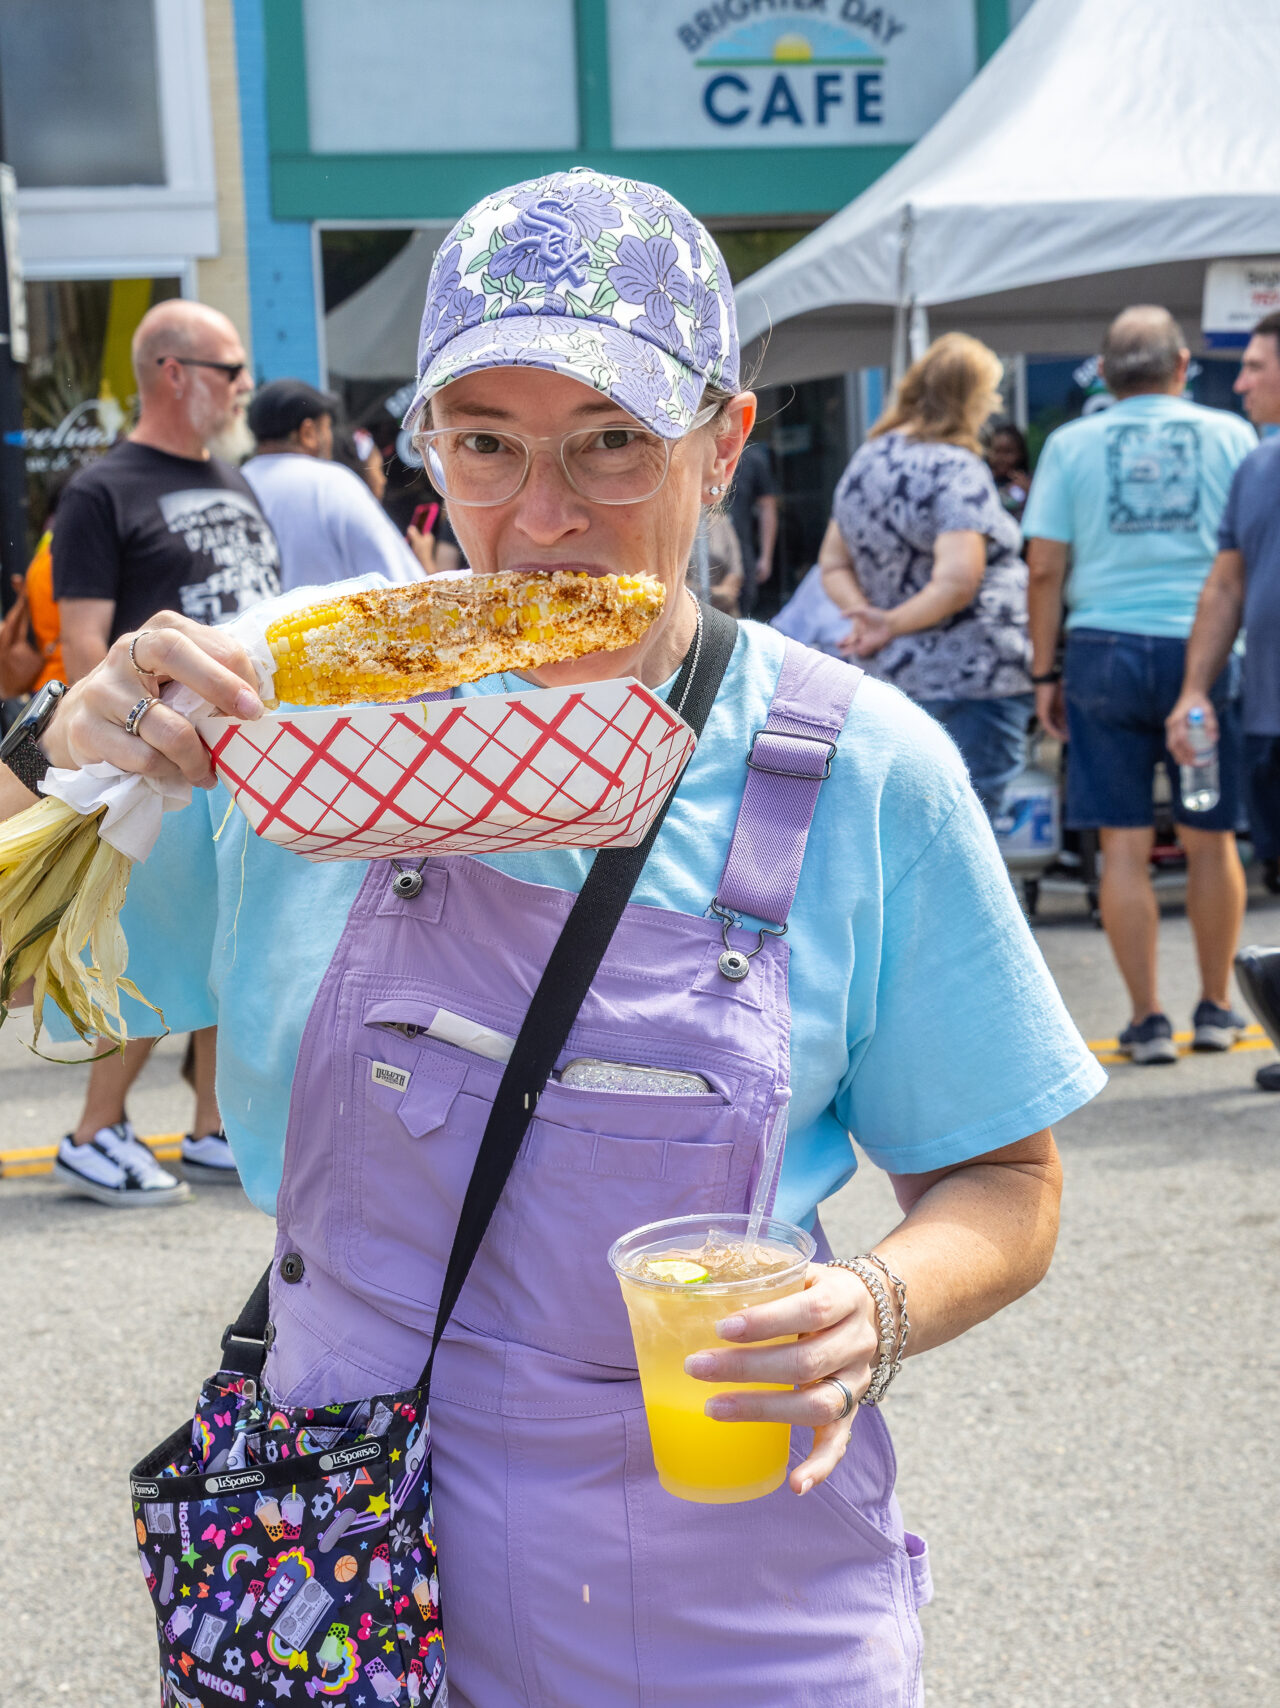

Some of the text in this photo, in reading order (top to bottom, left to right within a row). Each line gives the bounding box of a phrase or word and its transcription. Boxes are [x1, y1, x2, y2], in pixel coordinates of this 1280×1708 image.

[839, 0, 907, 45] DAY
[701, 72, 884, 128] CAFE
[510, 199, 591, 288] Sox
[375, 1067, 407, 1087] DULUTH
[260, 1572, 295, 1618] NICE
[196, 1668, 247, 1702] WHOA
[423, 1655, 442, 1700] NICE
